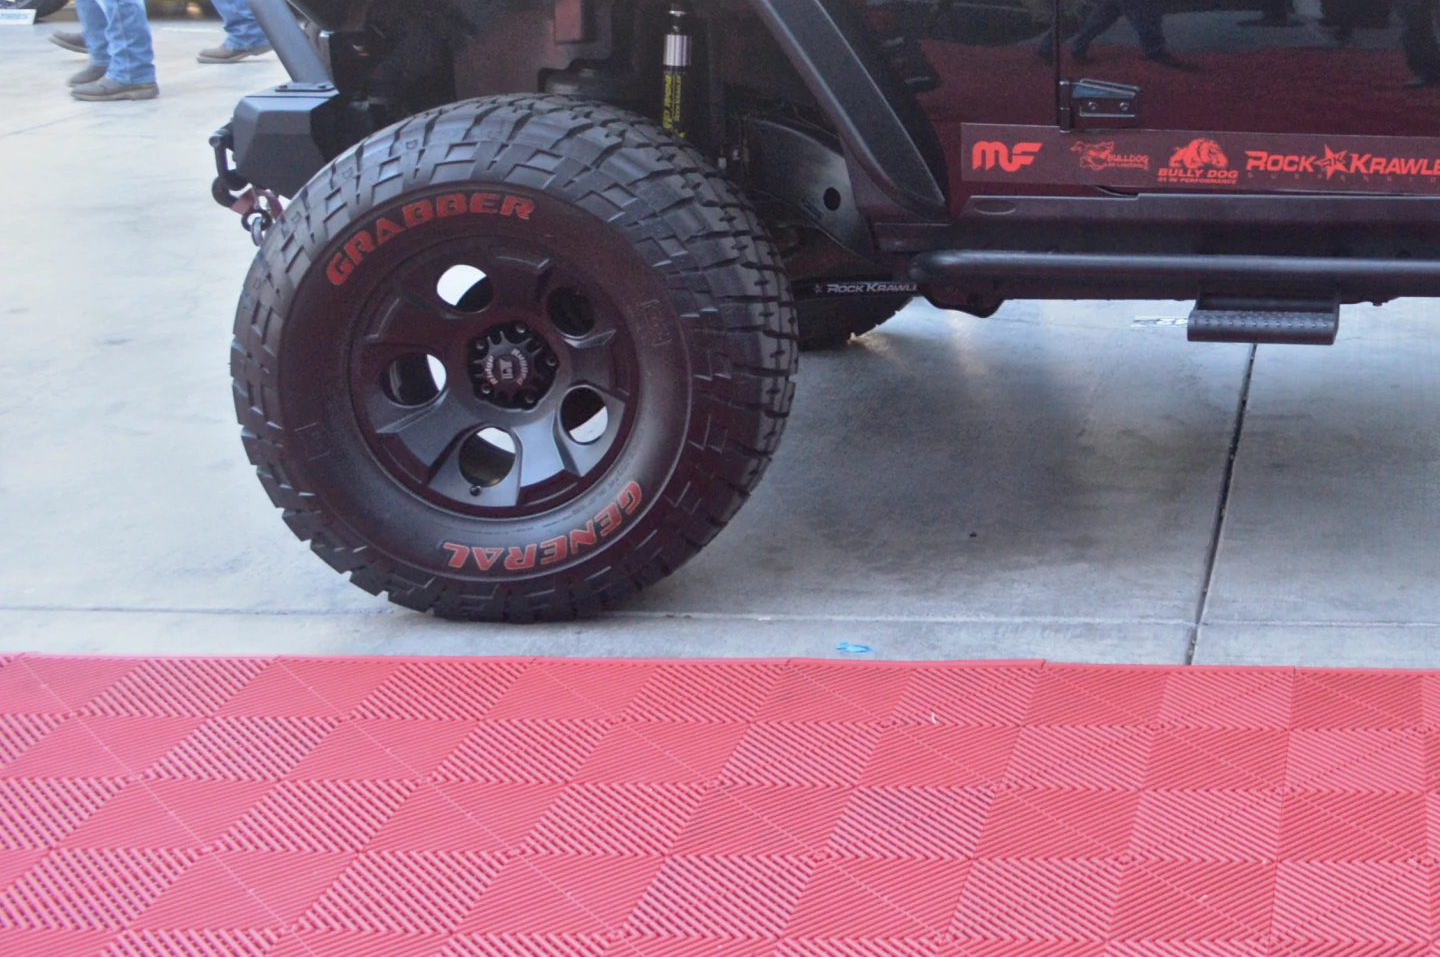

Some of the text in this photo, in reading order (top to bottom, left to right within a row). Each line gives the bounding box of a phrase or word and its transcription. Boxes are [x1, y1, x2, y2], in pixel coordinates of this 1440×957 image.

[972, 140, 1043, 172] MF
[1244, 150, 1316, 172] ROCK
[1158, 168, 1239, 178] BULLY DOG
[325, 192, 536, 286] GRABBER
[826, 283, 865, 294] ROCK
[442, 480, 643, 571] GENERAL
